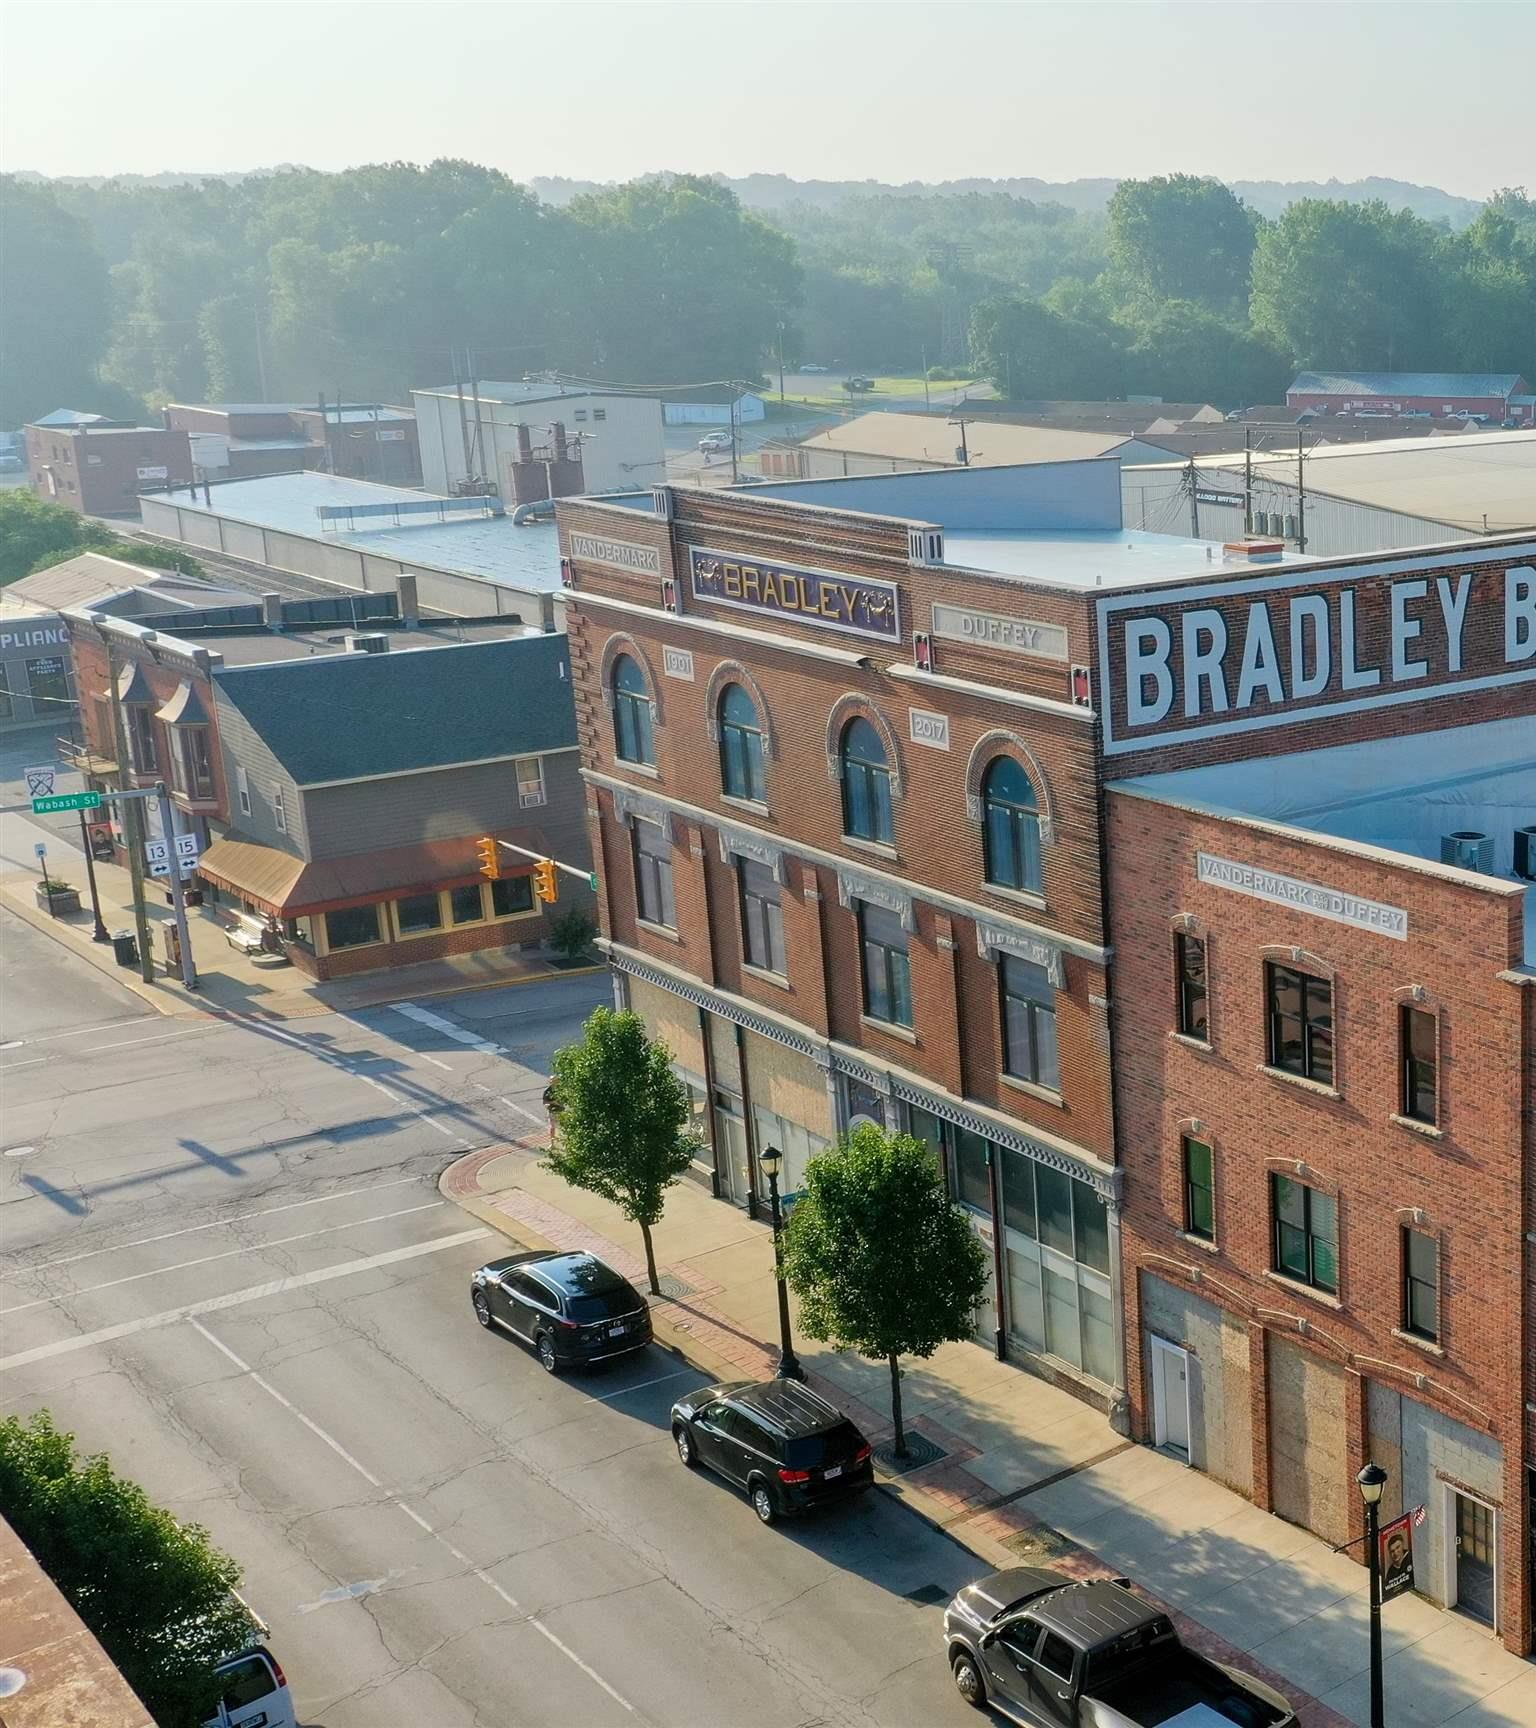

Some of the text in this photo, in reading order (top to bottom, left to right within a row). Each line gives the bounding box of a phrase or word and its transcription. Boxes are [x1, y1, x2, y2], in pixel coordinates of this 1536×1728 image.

[573, 537, 656, 569] VANDERMARK
[723, 563, 860, 622] BRADLEY
[962, 614, 1038, 649] DUFFEY
[668, 653, 690, 671] 1901
[1124, 574, 1473, 727] BRADLEY
[914, 718, 945, 739] 2017
[36, 796, 96, 811] Wabash St
[150, 846, 166, 859] 13
[178, 840, 193, 853] 15
[1201, 859, 1402, 930] VANDERMARK DUFFEY
